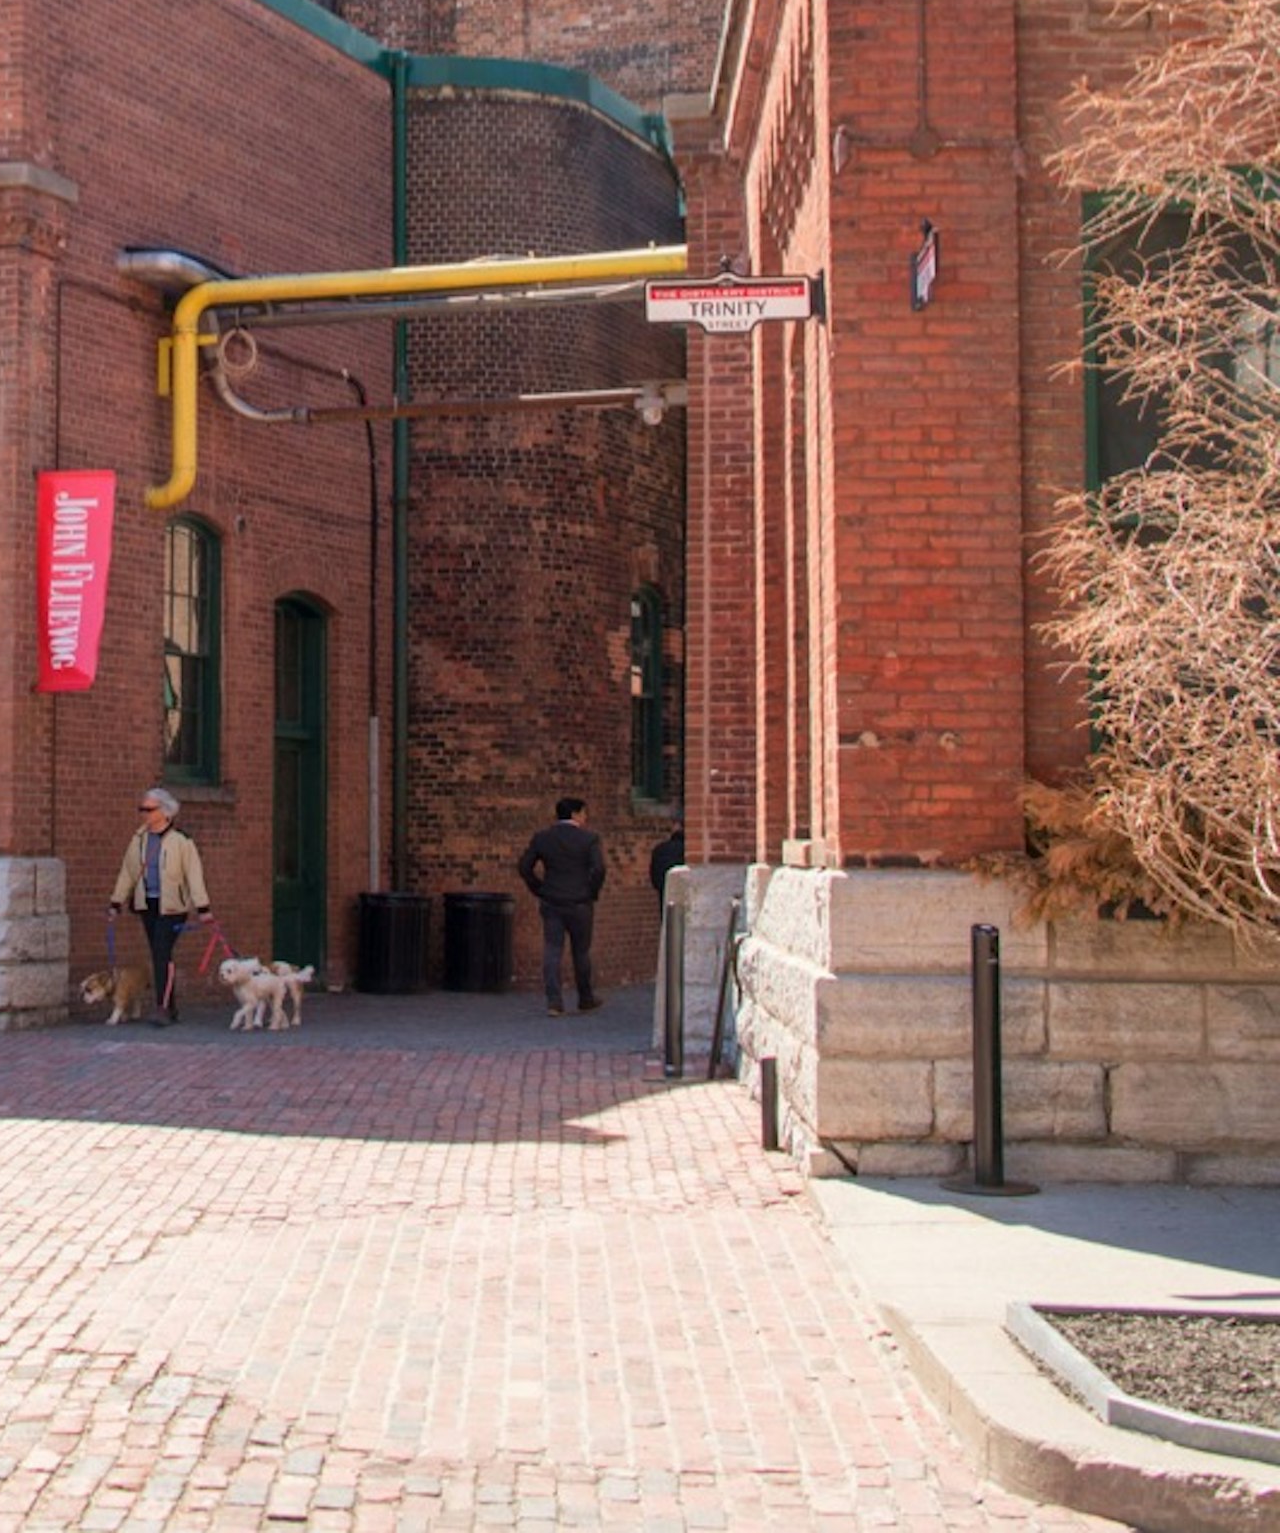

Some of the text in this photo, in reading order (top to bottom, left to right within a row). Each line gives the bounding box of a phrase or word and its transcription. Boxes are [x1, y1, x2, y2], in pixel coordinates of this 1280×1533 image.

[654, 286, 800, 299] THE DISTILLERY DISTRICT
[689, 300, 767, 317] TRINITY
[708, 320, 748, 329] STREET
[48, 491, 99, 670] JOHN FLUEVOG
